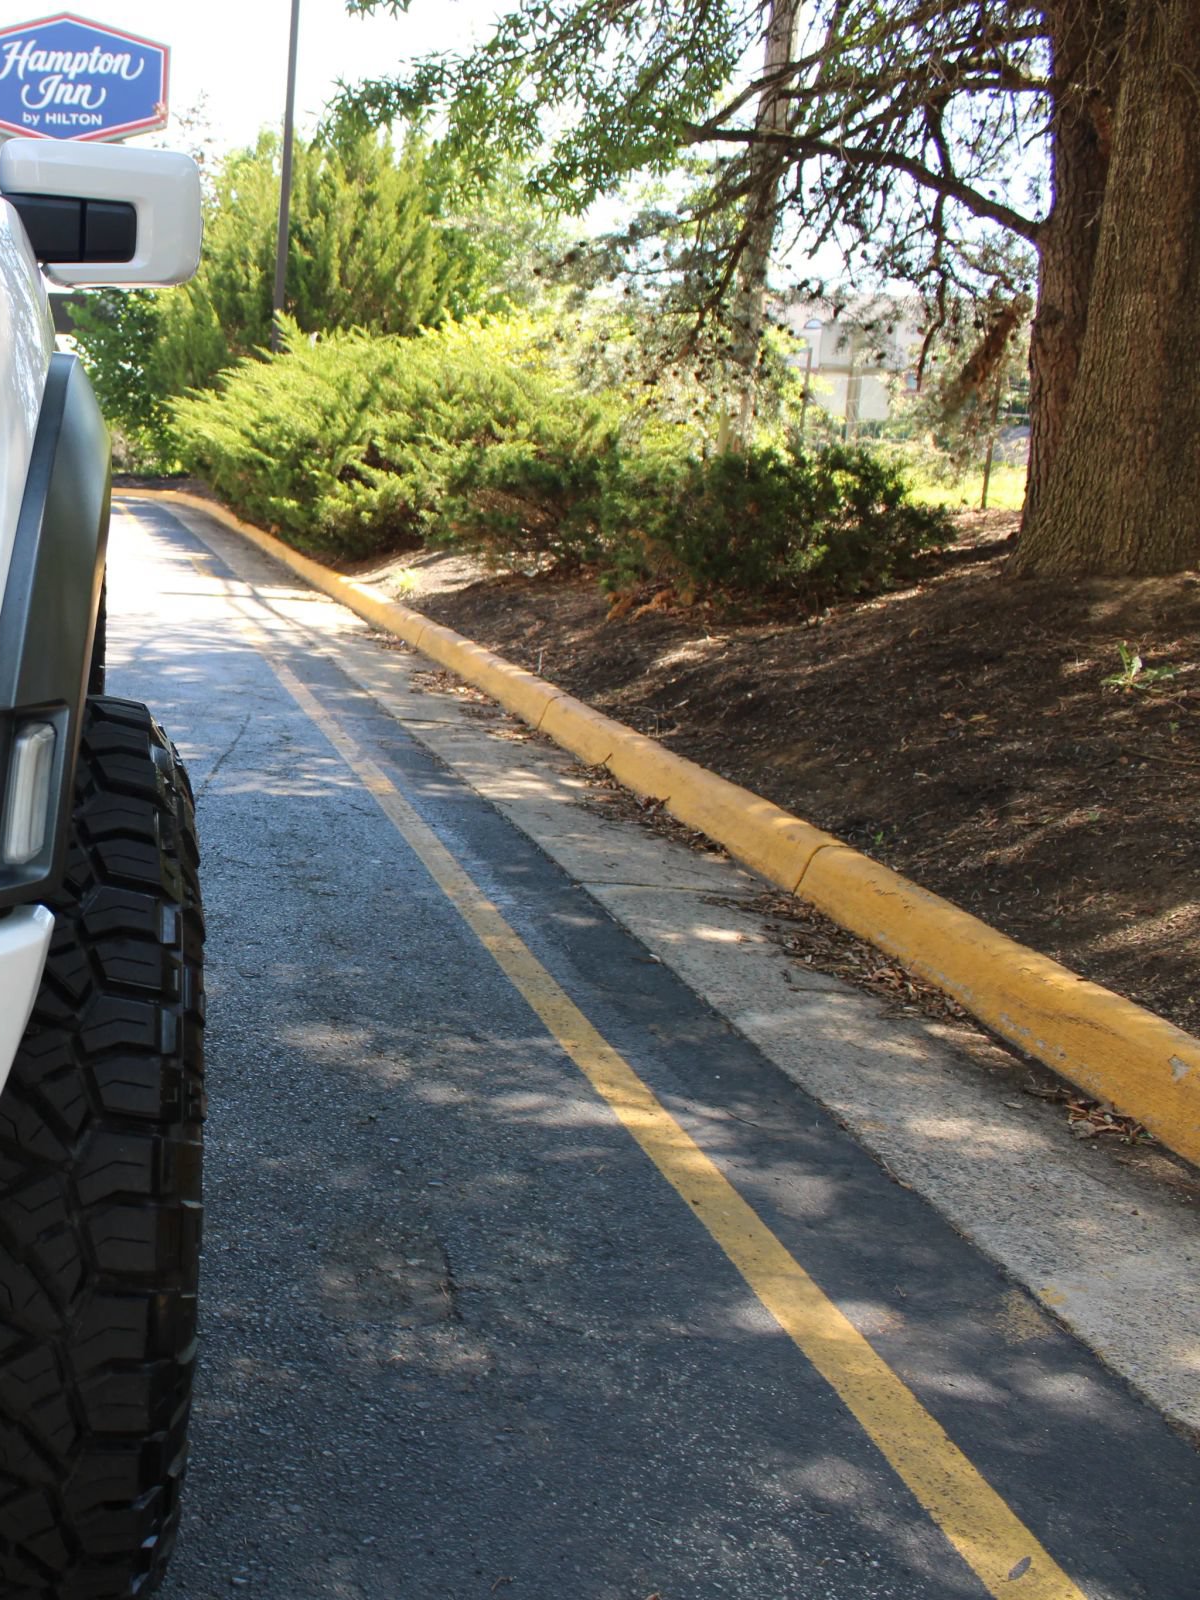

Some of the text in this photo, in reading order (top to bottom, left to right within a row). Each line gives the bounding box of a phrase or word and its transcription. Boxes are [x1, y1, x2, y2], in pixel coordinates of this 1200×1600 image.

[21, 75, 107, 109] Inn
[22, 112, 102, 126] by HILTON
